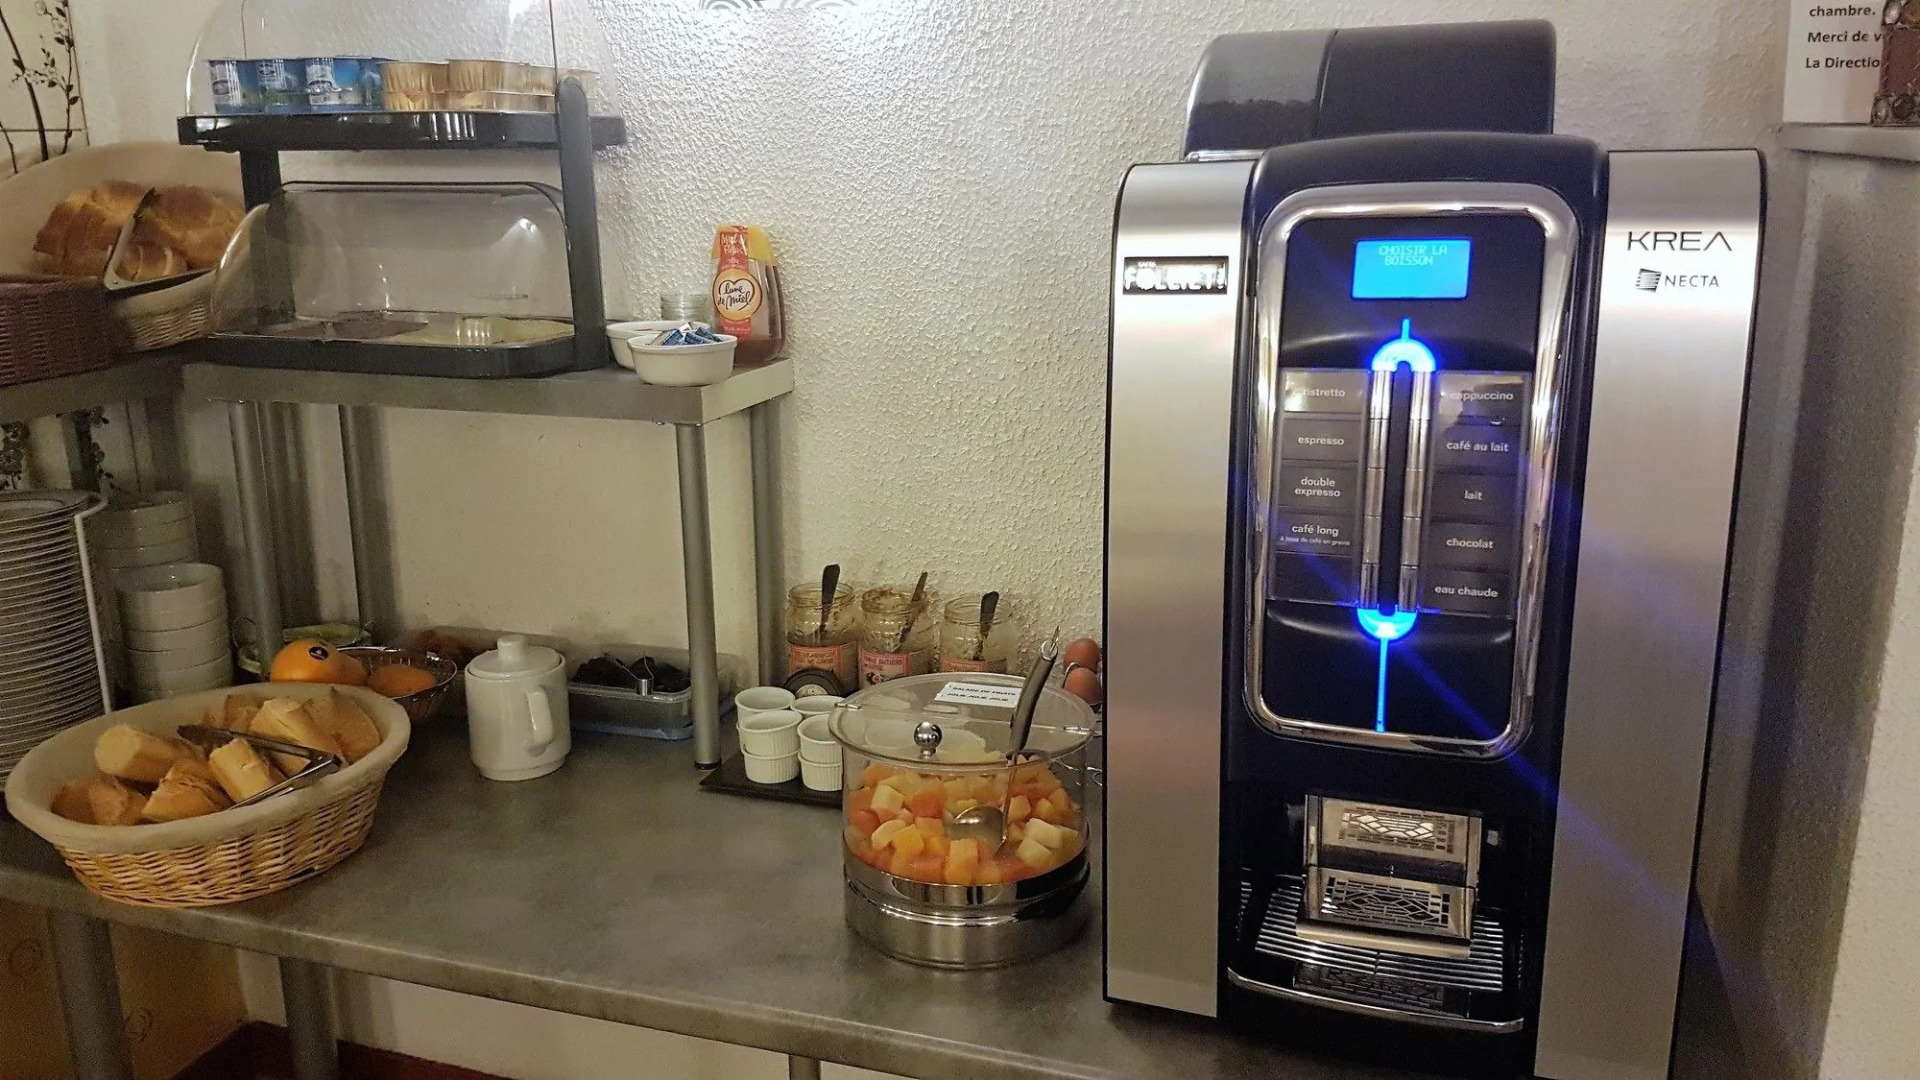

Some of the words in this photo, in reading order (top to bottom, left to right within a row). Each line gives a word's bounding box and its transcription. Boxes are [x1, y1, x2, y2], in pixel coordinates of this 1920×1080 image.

[1809, 5, 1876, 17] chambre.
[1807, 30, 1848, 42] Merci
[1852, 30, 1869, 42] de
[1805, 57, 1820, 68] La
[1627, 231, 1732, 251] KREA
[1378, 245, 1427, 256] CHOISIR
[1432, 245, 1448, 256] LA
[1383, 255, 1434, 267] BOISSON
[1664, 275, 1719, 287] NECTA
[1449, 391, 1514, 402] cappuccino
[1297, 436, 1345, 446] espresso
[1446, 440, 1471, 450] café
[1473, 443, 1488, 452] au
[1490, 441, 1509, 452] lait
[1300, 477, 1336, 487] double
[1294, 488, 1341, 497] expresso
[1464, 490, 1483, 500] lait
[1291, 524, 1314, 534] café
[1317, 525, 1339, 537] long
[1446, 538, 1494, 549] chocolat
[1434, 586, 1455, 595] eau
[1457, 587, 1499, 598] chaude
